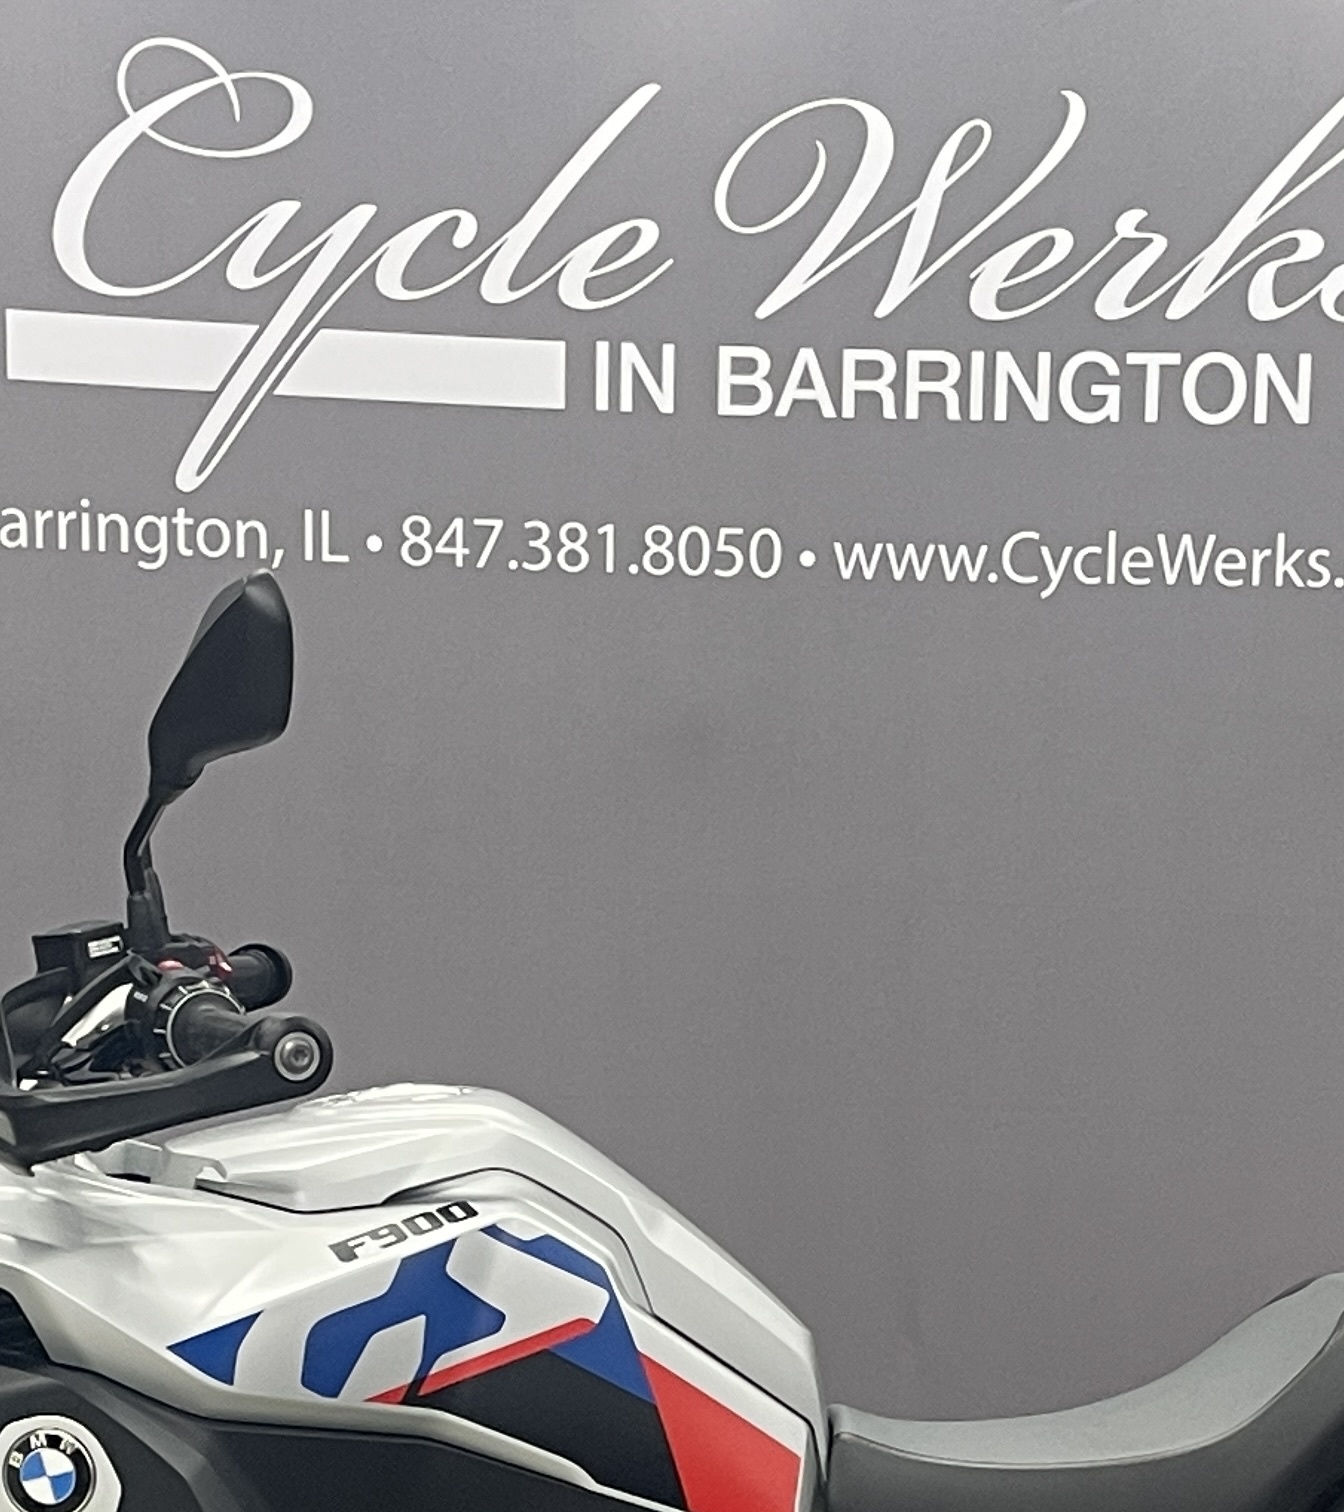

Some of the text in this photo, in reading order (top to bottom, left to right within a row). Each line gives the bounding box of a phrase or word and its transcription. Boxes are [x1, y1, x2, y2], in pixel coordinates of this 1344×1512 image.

[52, 37, 675, 492] Cycle
[595, 340, 1313, 426] IN BARRINGTON
[304, 508, 350, 564] IL
[400, 515, 783, 580] 847.381.8050
[328, 1200, 479, 1262] F900
[8, 1431, 77, 1469] BMW
